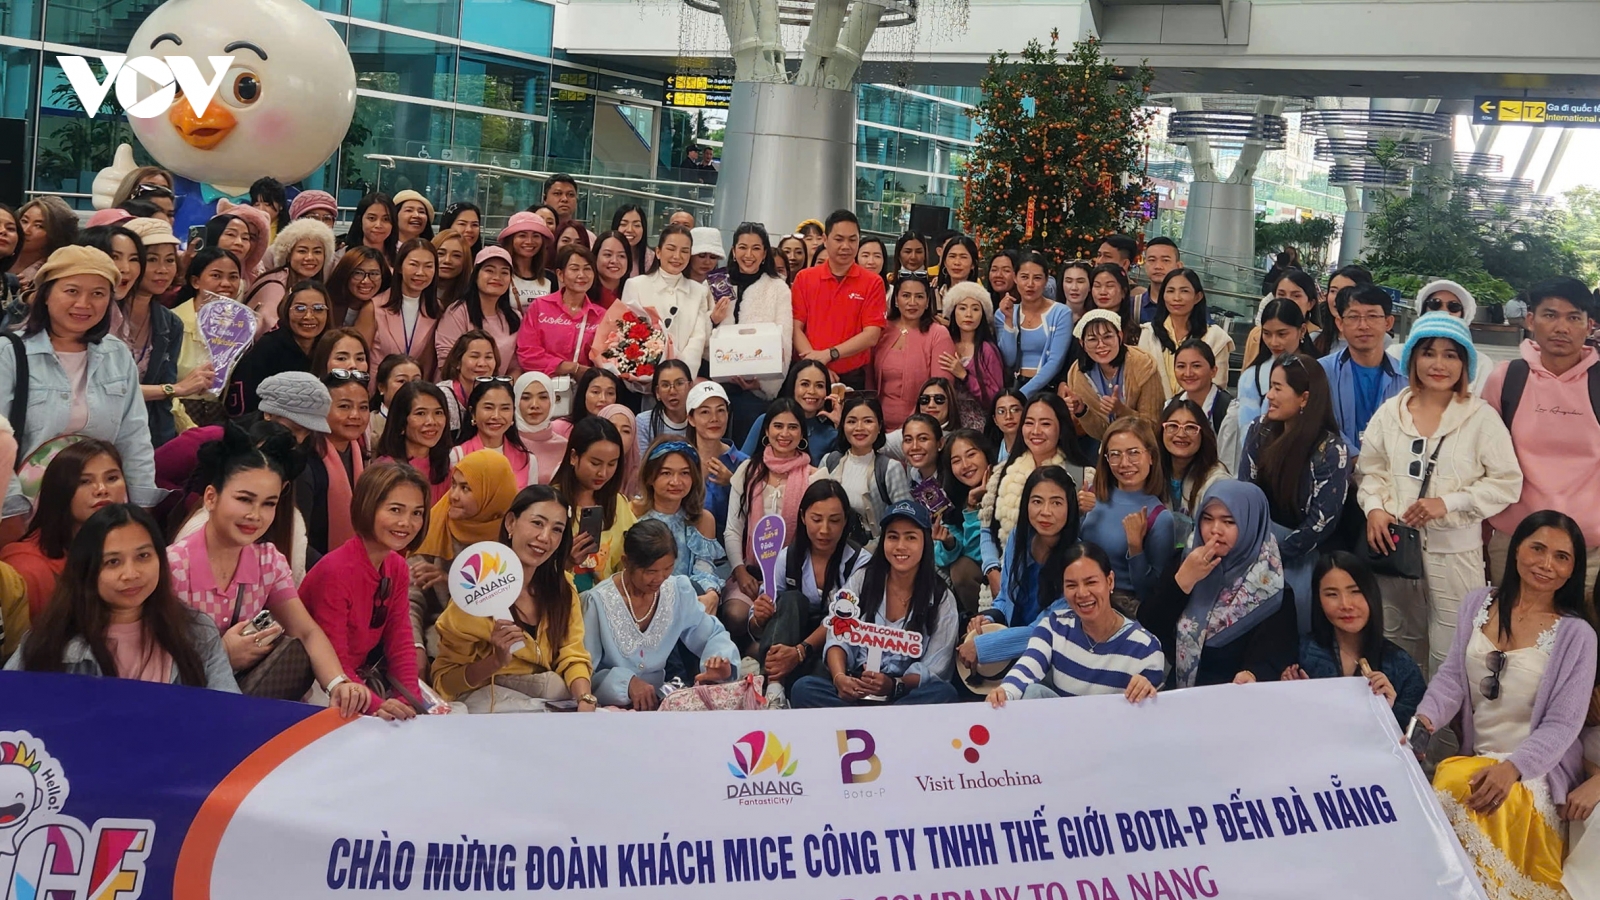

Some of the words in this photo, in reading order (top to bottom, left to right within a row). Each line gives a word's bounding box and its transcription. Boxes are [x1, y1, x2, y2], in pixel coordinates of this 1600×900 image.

[1524, 105, 1545, 118] T2
[1546, 113, 1597, 122] International
[1547, 103, 1559, 111] Ga
[1561, 103, 1570, 112] đi
[1571, 103, 1592, 113] quốc
[464, 573, 516, 605] DANANG
[860, 623, 904, 638] WELCOME
[908, 633, 920, 641] TO
[850, 631, 920, 656] DANANG
[41, 768, 61, 810] Hello!
[727, 781, 803, 799] DANANG
[915, 775, 956, 792] Visit
[958, 769, 1042, 790] Indochina
[843, 788, 886, 799] Bota-P
[326, 830, 416, 890] CHÀO
[422, 834, 517, 891] MỪNG
[525, 836, 609, 891] ĐOÀN
[617, 832, 716, 887] KHÁCH
[723, 836, 797, 883] MICE
[803, 823, 882, 878] CÔNG
[884, 828, 917, 872] TY
[923, 822, 999, 869] TNHH
[1001, 805, 1054, 863] THẾ
[1057, 806, 1115, 859] GIỚI
[1117, 806, 1208, 853] BOTA-P
[1212, 788, 1275, 843] ĐẾN
[1271, 786, 1318, 836] ĐÀ
[1313, 774, 1398, 831] NẴNG
[1076, 877, 1119, 900] DA
[1127, 865, 1220, 900] NANG
